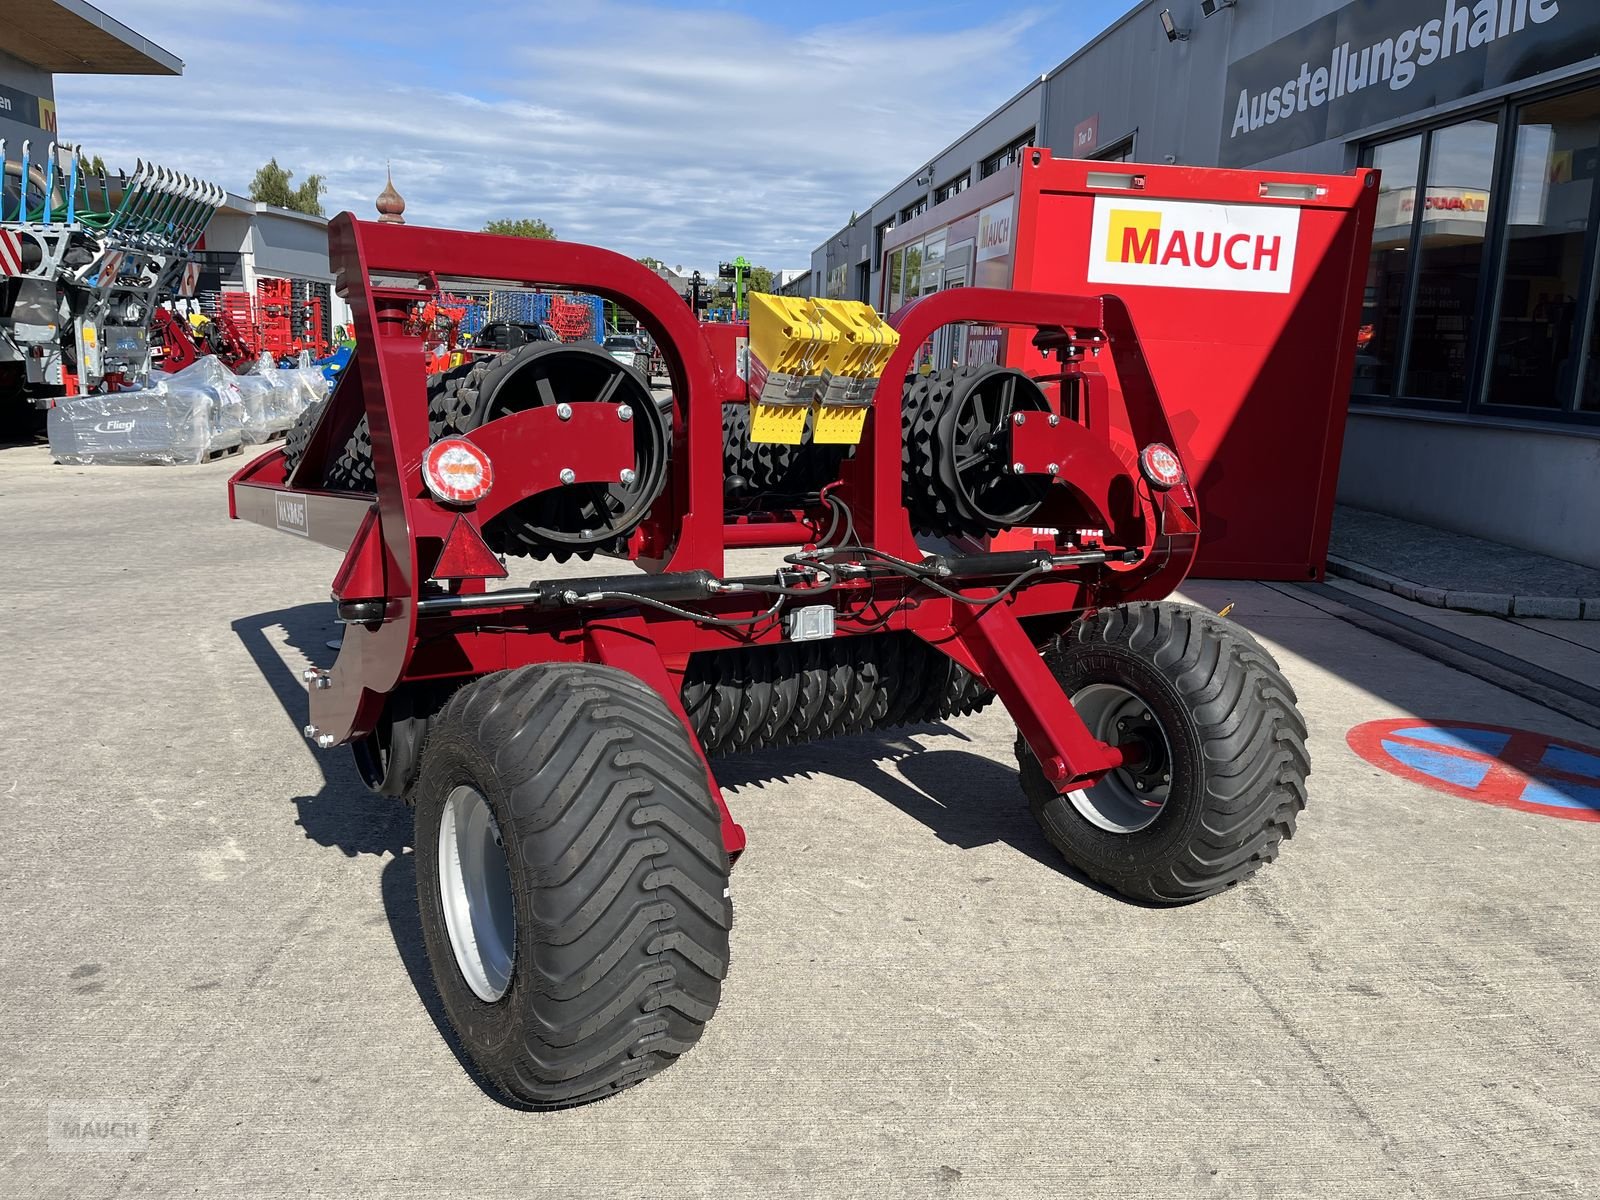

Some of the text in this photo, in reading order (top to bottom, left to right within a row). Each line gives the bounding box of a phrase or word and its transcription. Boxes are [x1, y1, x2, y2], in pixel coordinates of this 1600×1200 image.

[1087, 127, 1093, 142] D
[982, 216, 1010, 248] MAUCH
[1120, 226, 1282, 272] MAUCH
